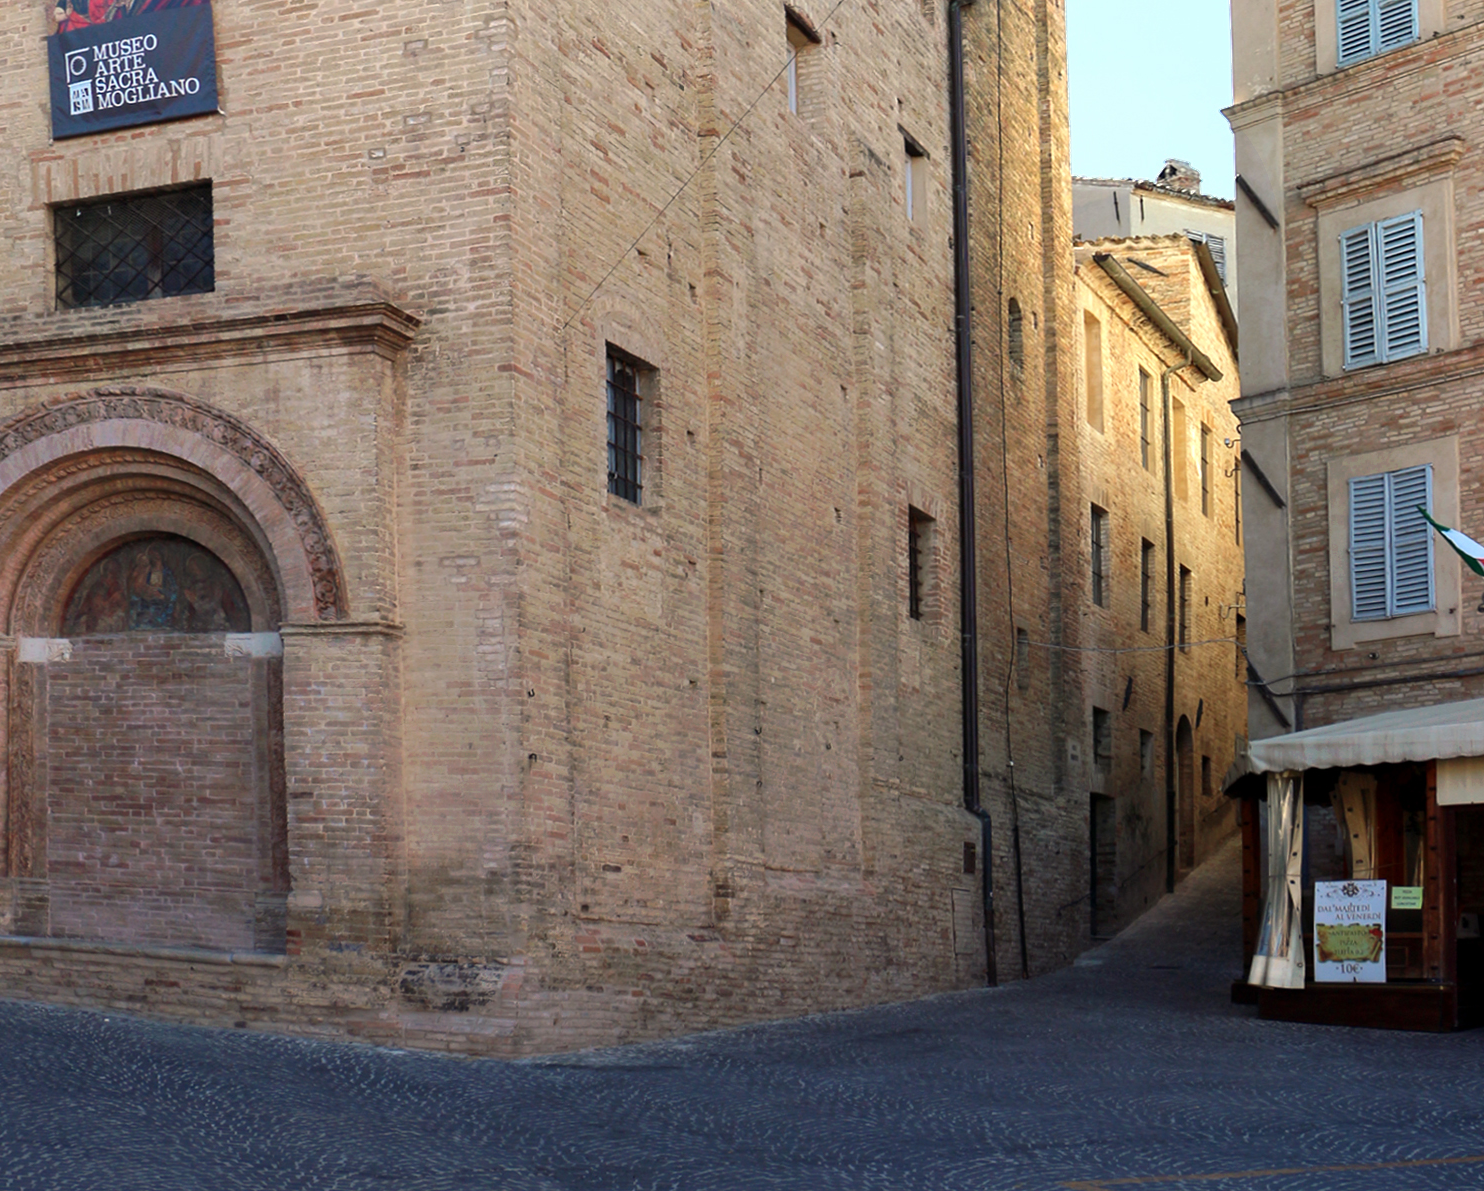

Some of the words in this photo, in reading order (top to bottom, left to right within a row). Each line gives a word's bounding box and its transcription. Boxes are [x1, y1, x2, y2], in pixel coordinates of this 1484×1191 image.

[92, 34, 157, 61] MUSEO
[95, 53, 146, 77] ARTE
[95, 68, 159, 93] SACRA
[97, 78, 200, 110] MOGLIANO
